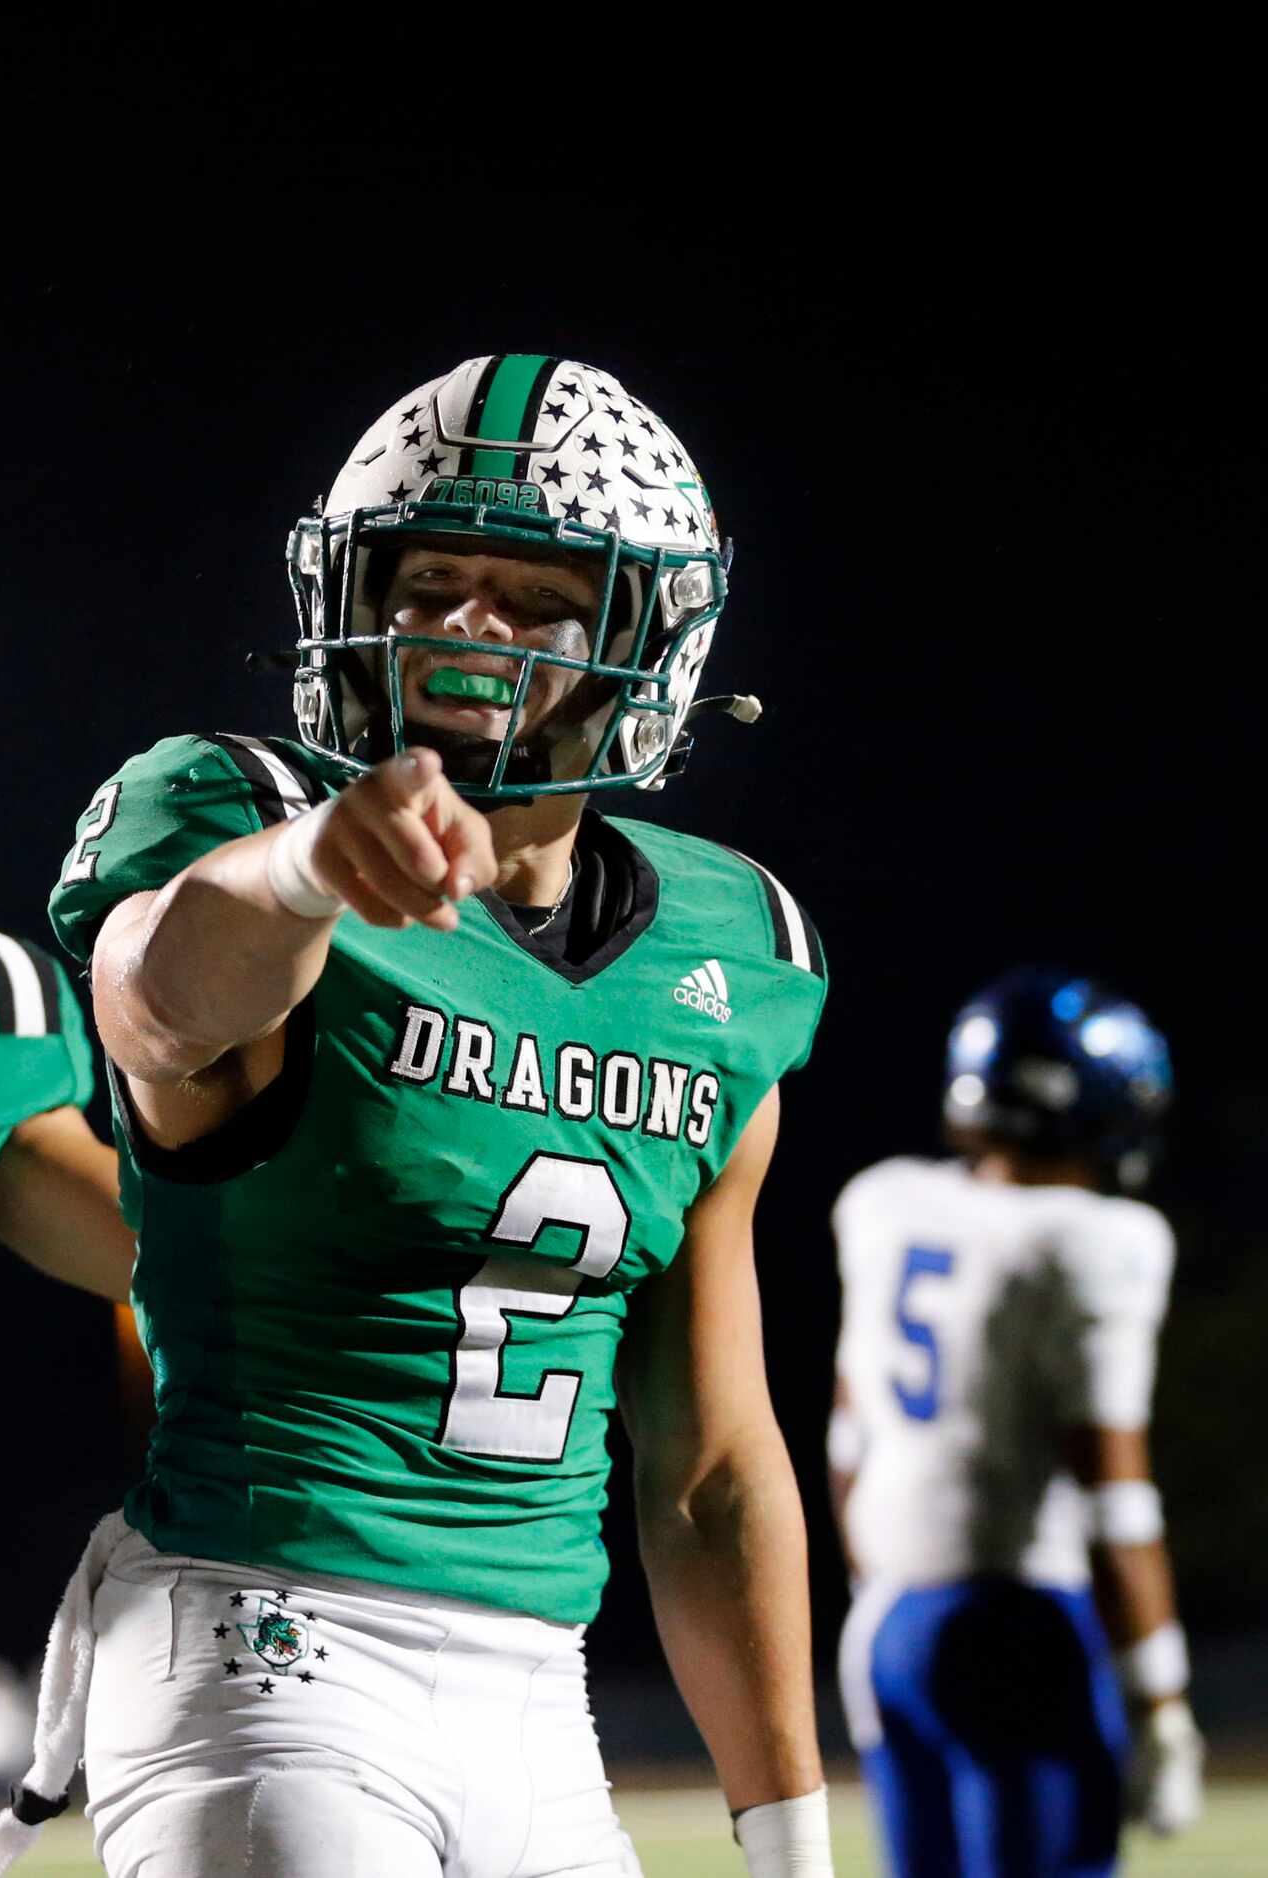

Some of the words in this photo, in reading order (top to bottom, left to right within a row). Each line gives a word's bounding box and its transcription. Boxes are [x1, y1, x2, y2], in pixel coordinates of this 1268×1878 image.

[433, 478, 541, 514] 76092
[62, 781, 123, 890] 2
[673, 986, 732, 1024] adidas
[388, 1001, 721, 1149] DRAGONS
[438, 1149, 633, 1465] 2
[892, 1245, 955, 1423] 5
